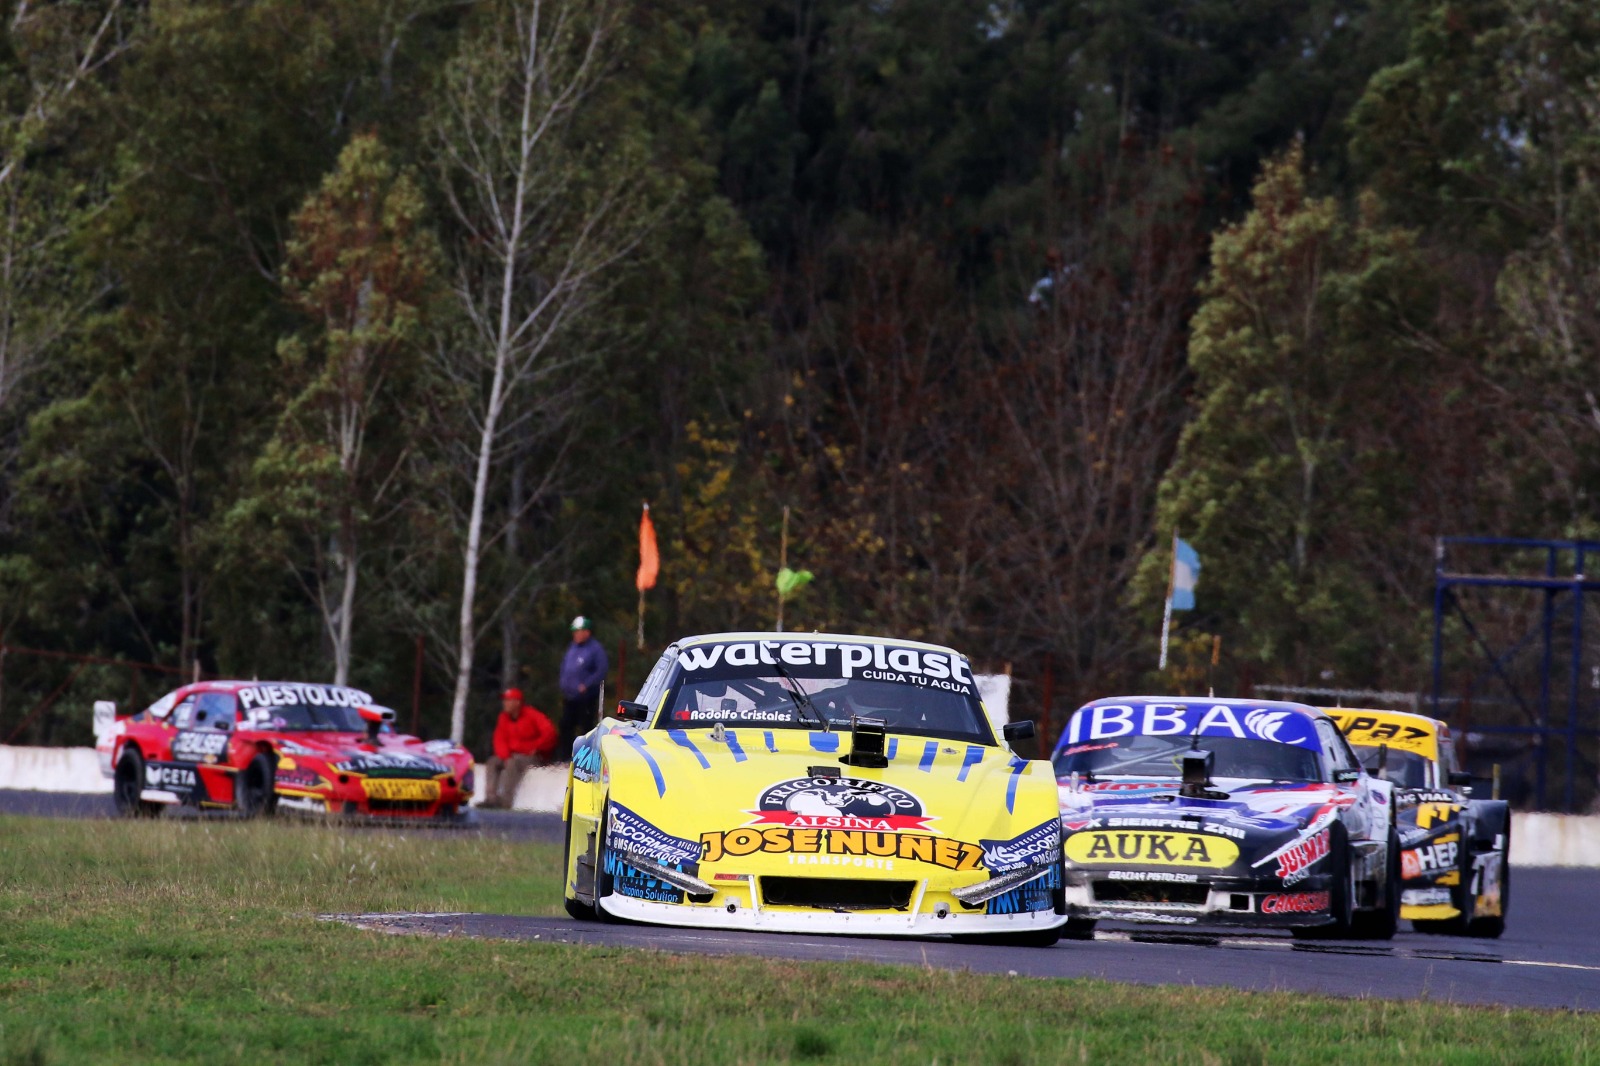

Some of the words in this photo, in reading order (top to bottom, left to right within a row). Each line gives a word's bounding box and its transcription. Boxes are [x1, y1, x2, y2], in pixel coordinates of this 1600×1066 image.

[677, 640, 973, 685] waterplast
[862, 669, 907, 683] CUIDA
[911, 674, 928, 687] TU
[930, 677, 971, 696] AGUA
[690, 709, 738, 721] Rodolfo
[740, 708, 792, 722] Cristales
[162, 767, 197, 786] CETA
[619, 812, 677, 845] REPRESENTANTE
[677, 840, 701, 854] OFICIAL
[789, 816, 893, 831] ALSINA
[1107, 817, 1200, 831] SIEMPRE
[700, 827, 826, 863] JOSE
[1085, 833, 1213, 863] AUKA
[787, 854, 894, 871] TRANSPORTE
[645, 887, 679, 903] Solution
